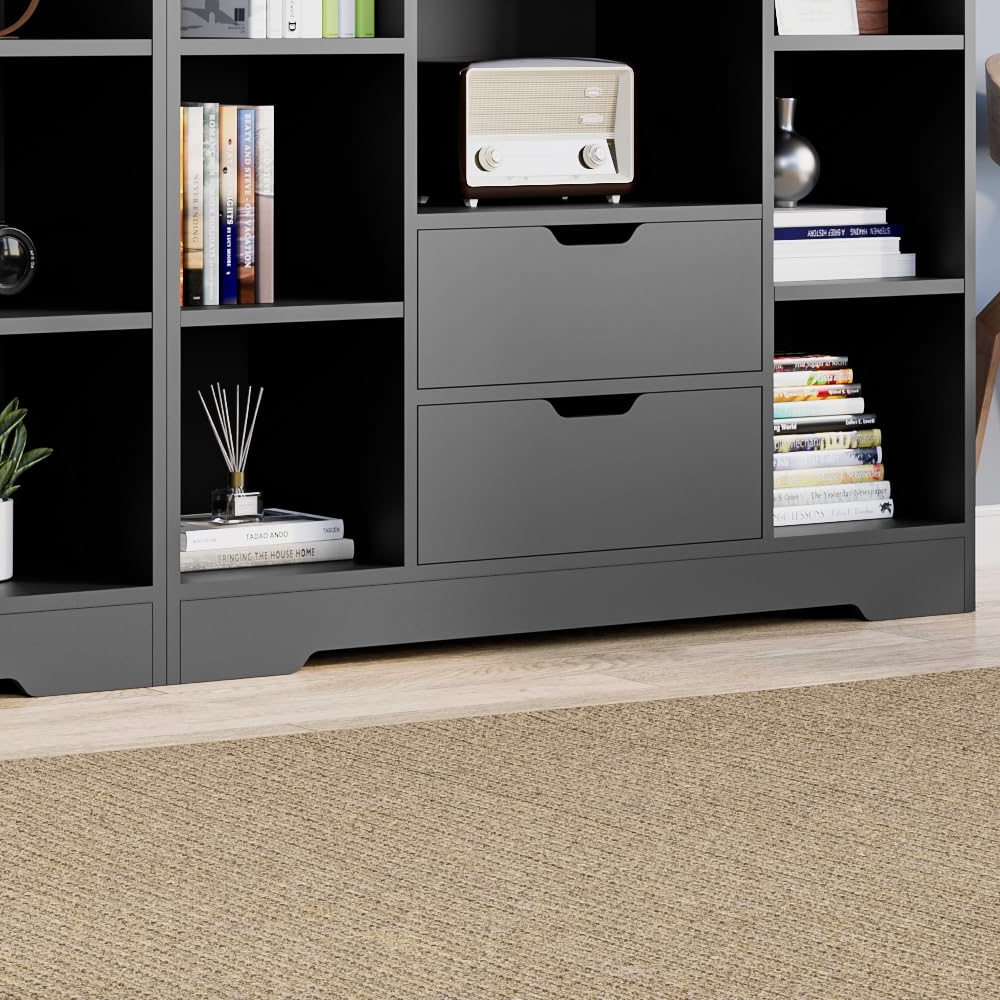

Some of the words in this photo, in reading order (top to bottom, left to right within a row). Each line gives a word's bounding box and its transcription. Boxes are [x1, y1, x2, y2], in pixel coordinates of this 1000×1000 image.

[244, 145, 252, 165] AND
[244, 167, 252, 196] STEVE
[244, 203, 252, 218] ON
[244, 218, 252, 269] VACATION
[269, 530, 289, 539] ANDO
[217, 552, 253, 564] BRINGING
[254, 551, 268, 561] THE
[270, 549, 294, 560] HOUSE
[295, 547, 316, 559] HOME
